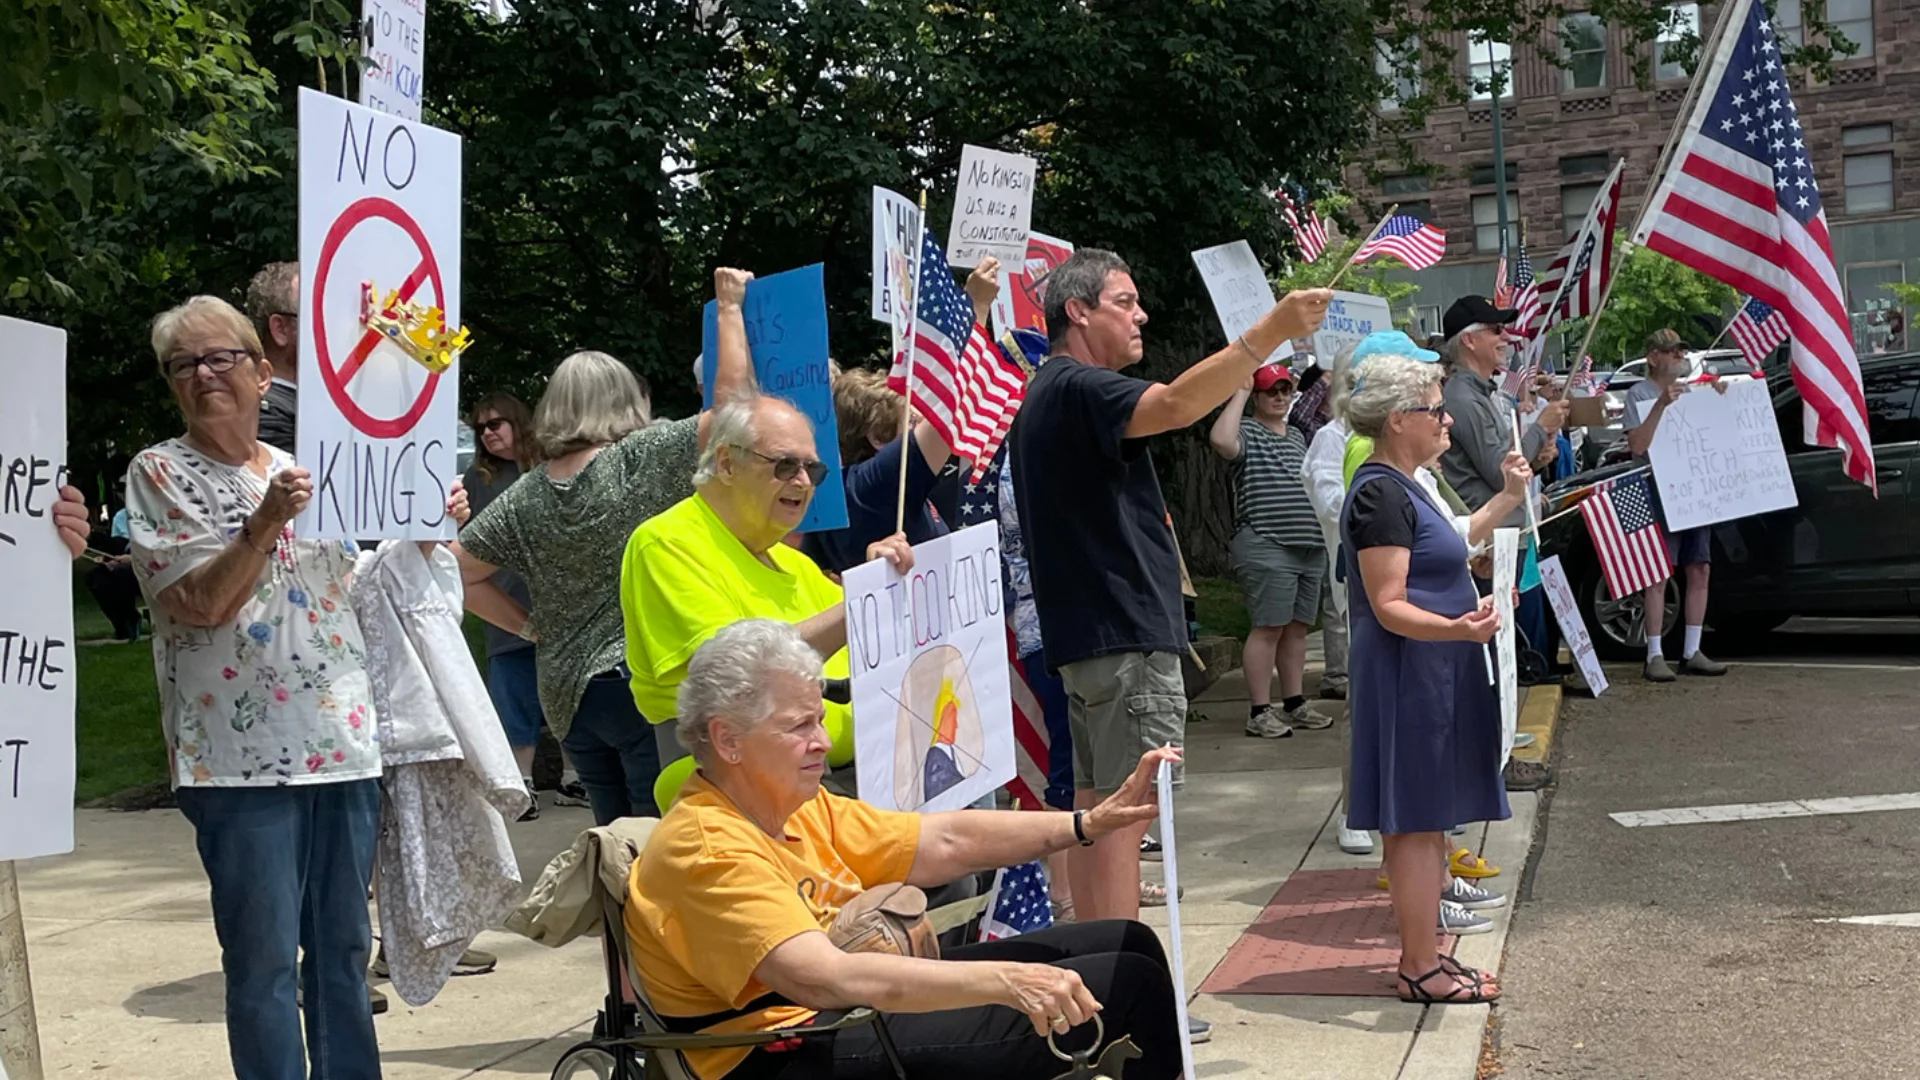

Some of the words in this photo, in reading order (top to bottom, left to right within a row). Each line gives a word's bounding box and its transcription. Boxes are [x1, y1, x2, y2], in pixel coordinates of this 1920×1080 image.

[373, 1, 392, 37] TO
[337, 109, 417, 190] NO
[318, 439, 446, 534] KINGS
[1688, 448, 1738, 478] RICH
[848, 590, 882, 679] NO
[945, 546, 1000, 636] KING
